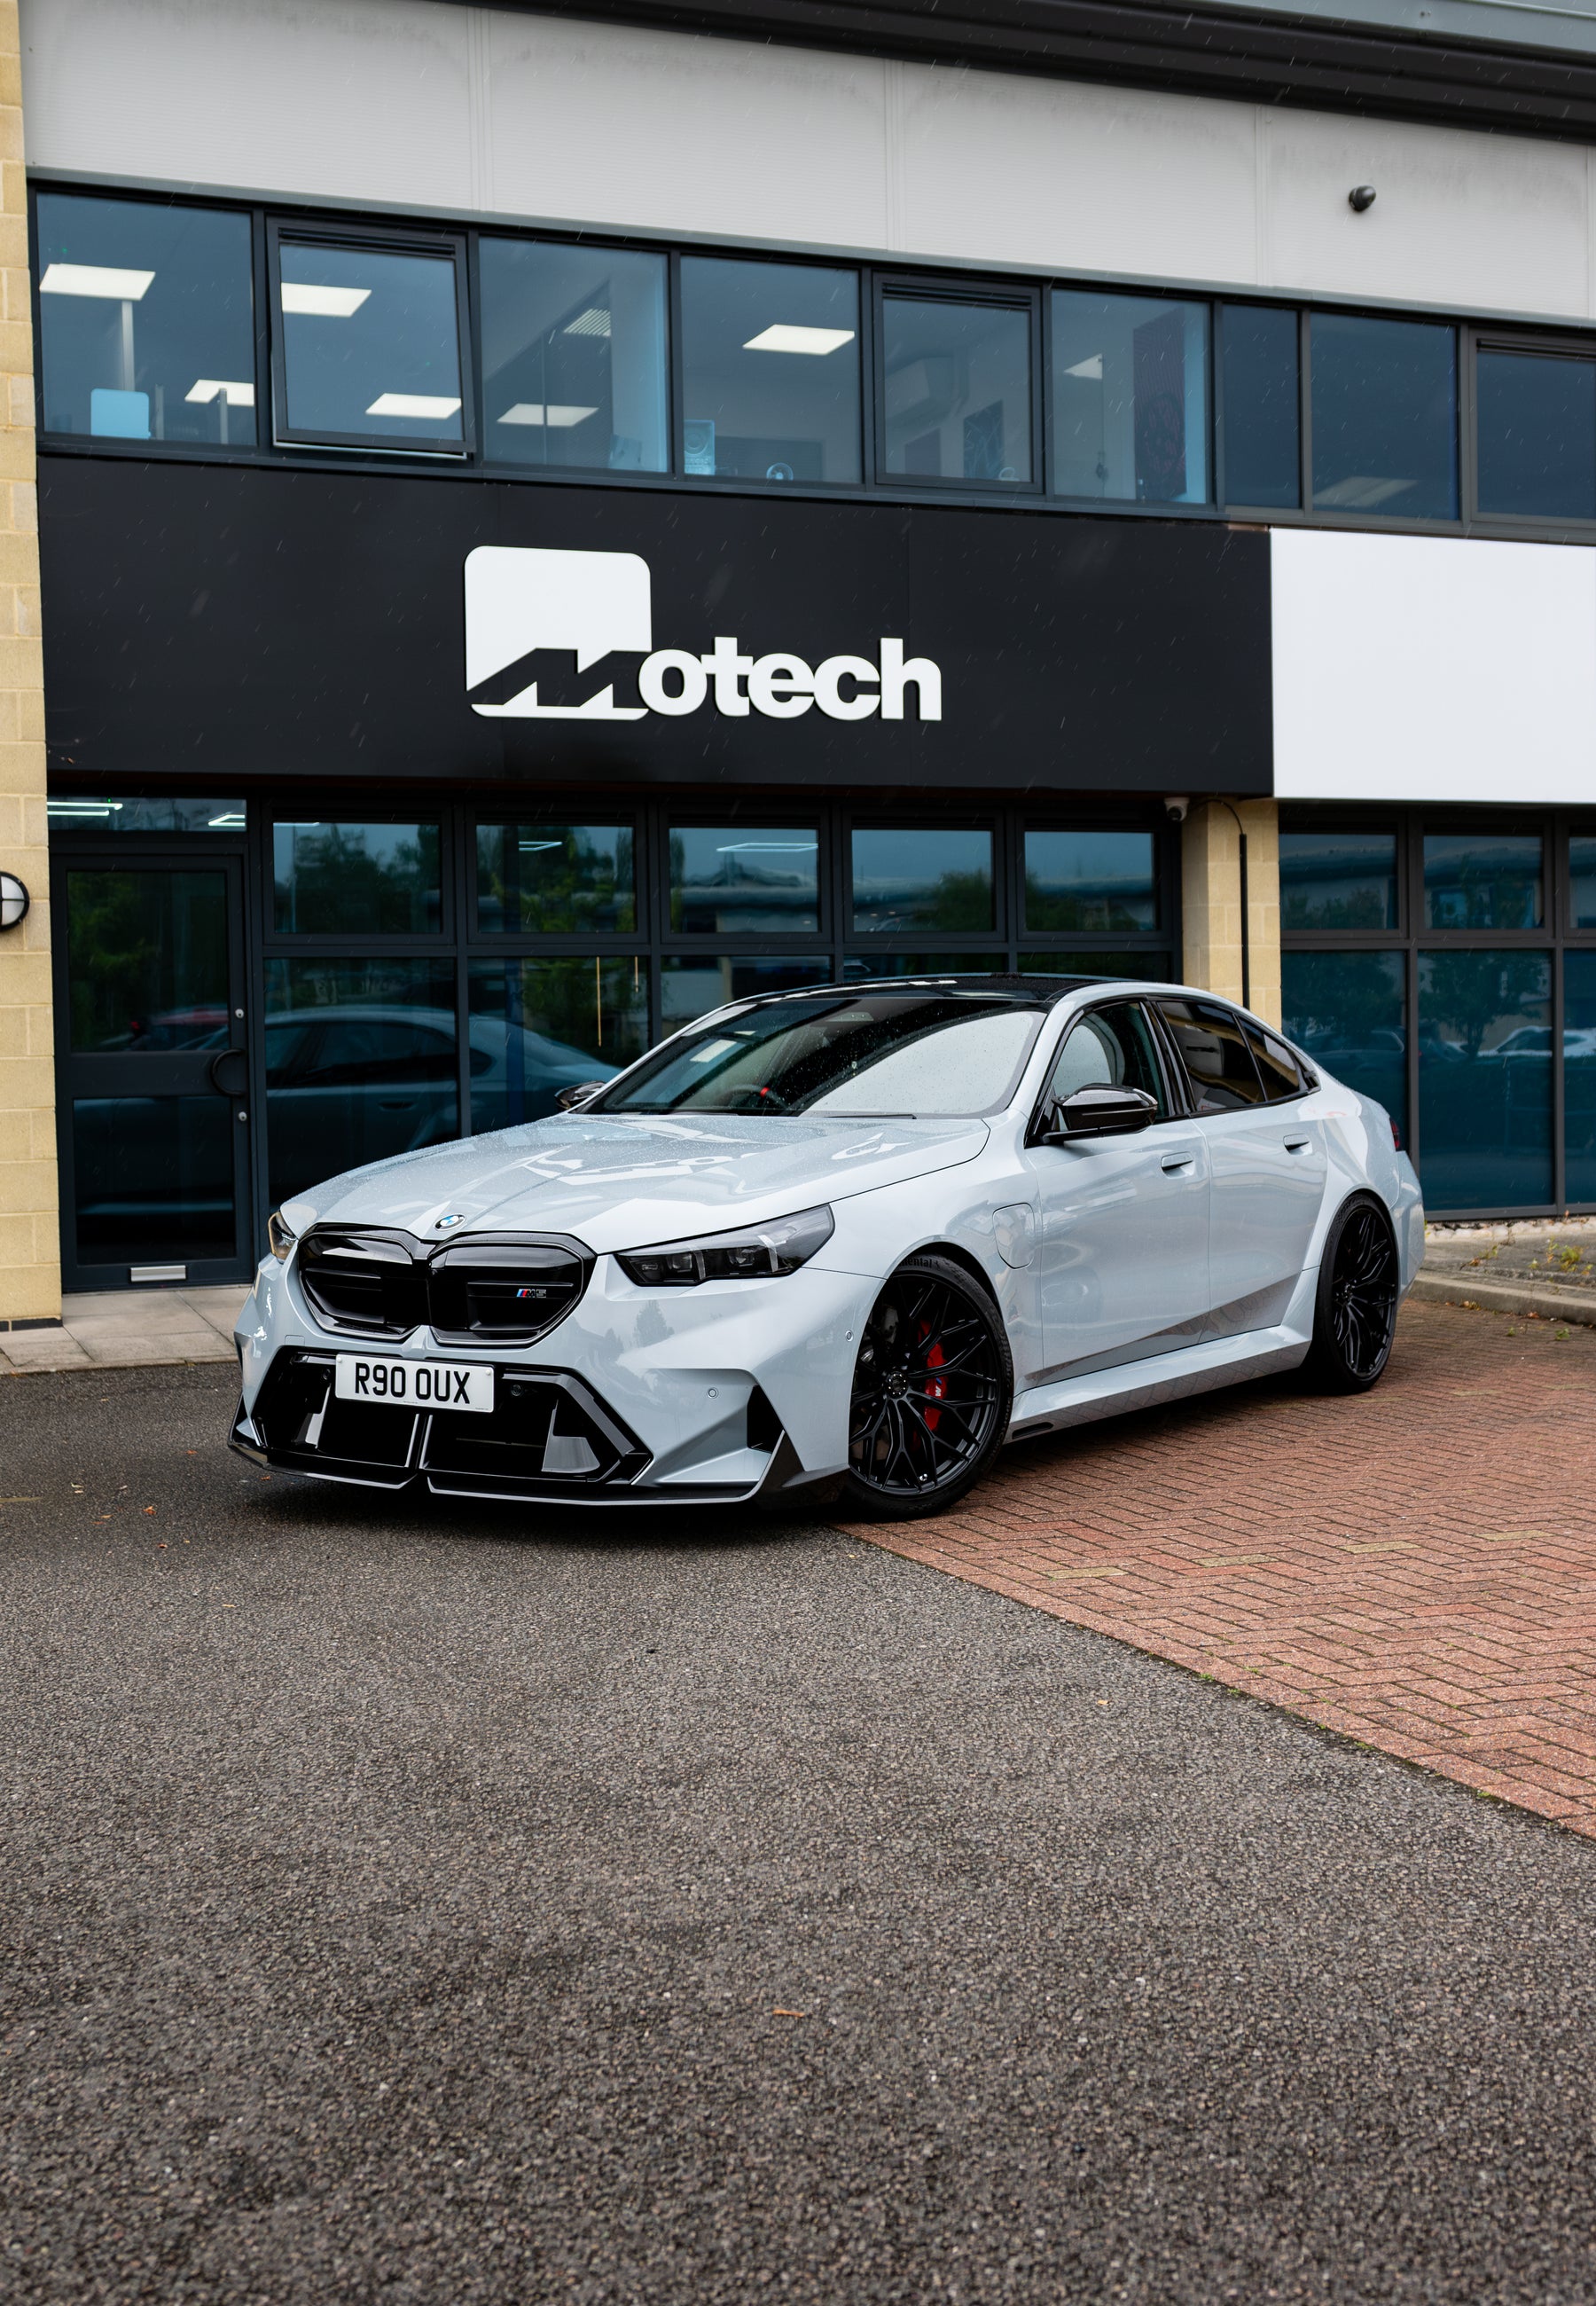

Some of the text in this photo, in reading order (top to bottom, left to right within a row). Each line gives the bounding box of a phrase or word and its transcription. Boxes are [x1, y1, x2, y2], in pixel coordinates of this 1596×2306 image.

[525, 1289, 546, 1298] M5
[355, 1362, 471, 1404] R90 OUX
